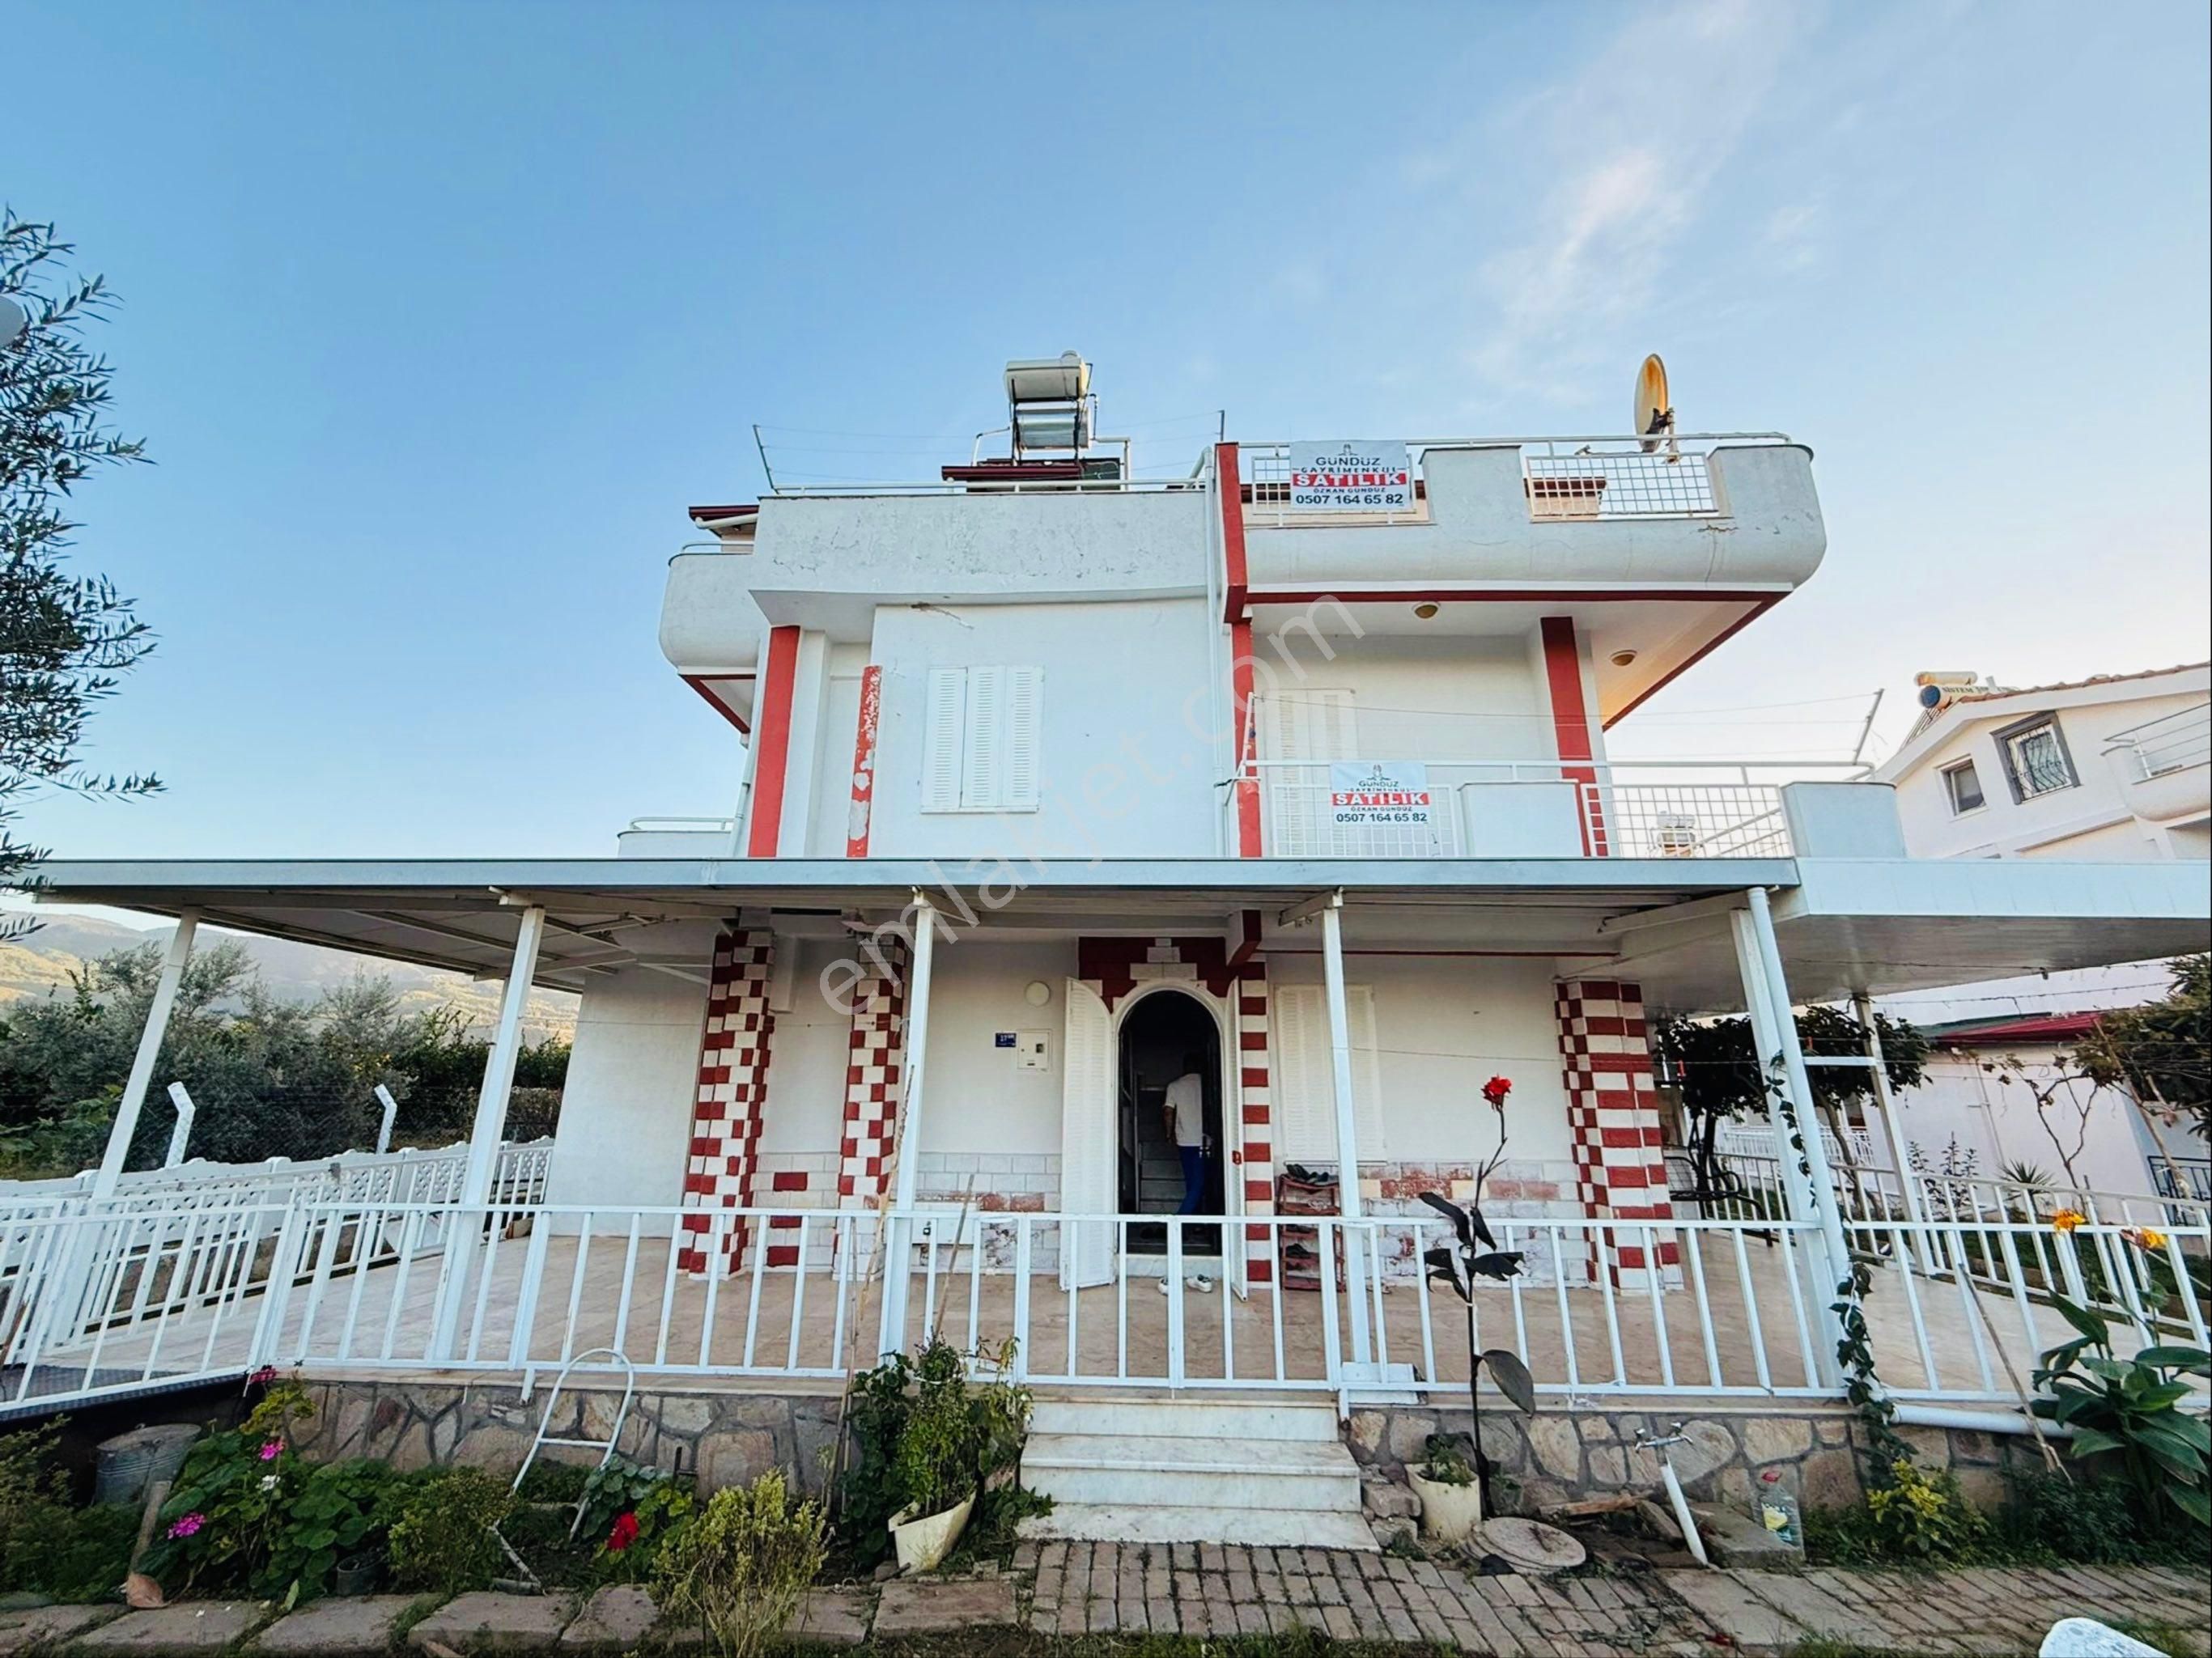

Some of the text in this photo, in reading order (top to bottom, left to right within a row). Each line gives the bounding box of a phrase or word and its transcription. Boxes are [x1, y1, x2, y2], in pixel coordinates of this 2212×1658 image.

[1315, 456, 1381, 466] GÜNDÜZ
[1296, 474, 1401, 486] SATILIK
[1296, 494, 1403, 504] 0507 164 65 82
[1335, 793, 1424, 805] SATILIK
[1336, 812, 1427, 822] 0507 164 65 82
